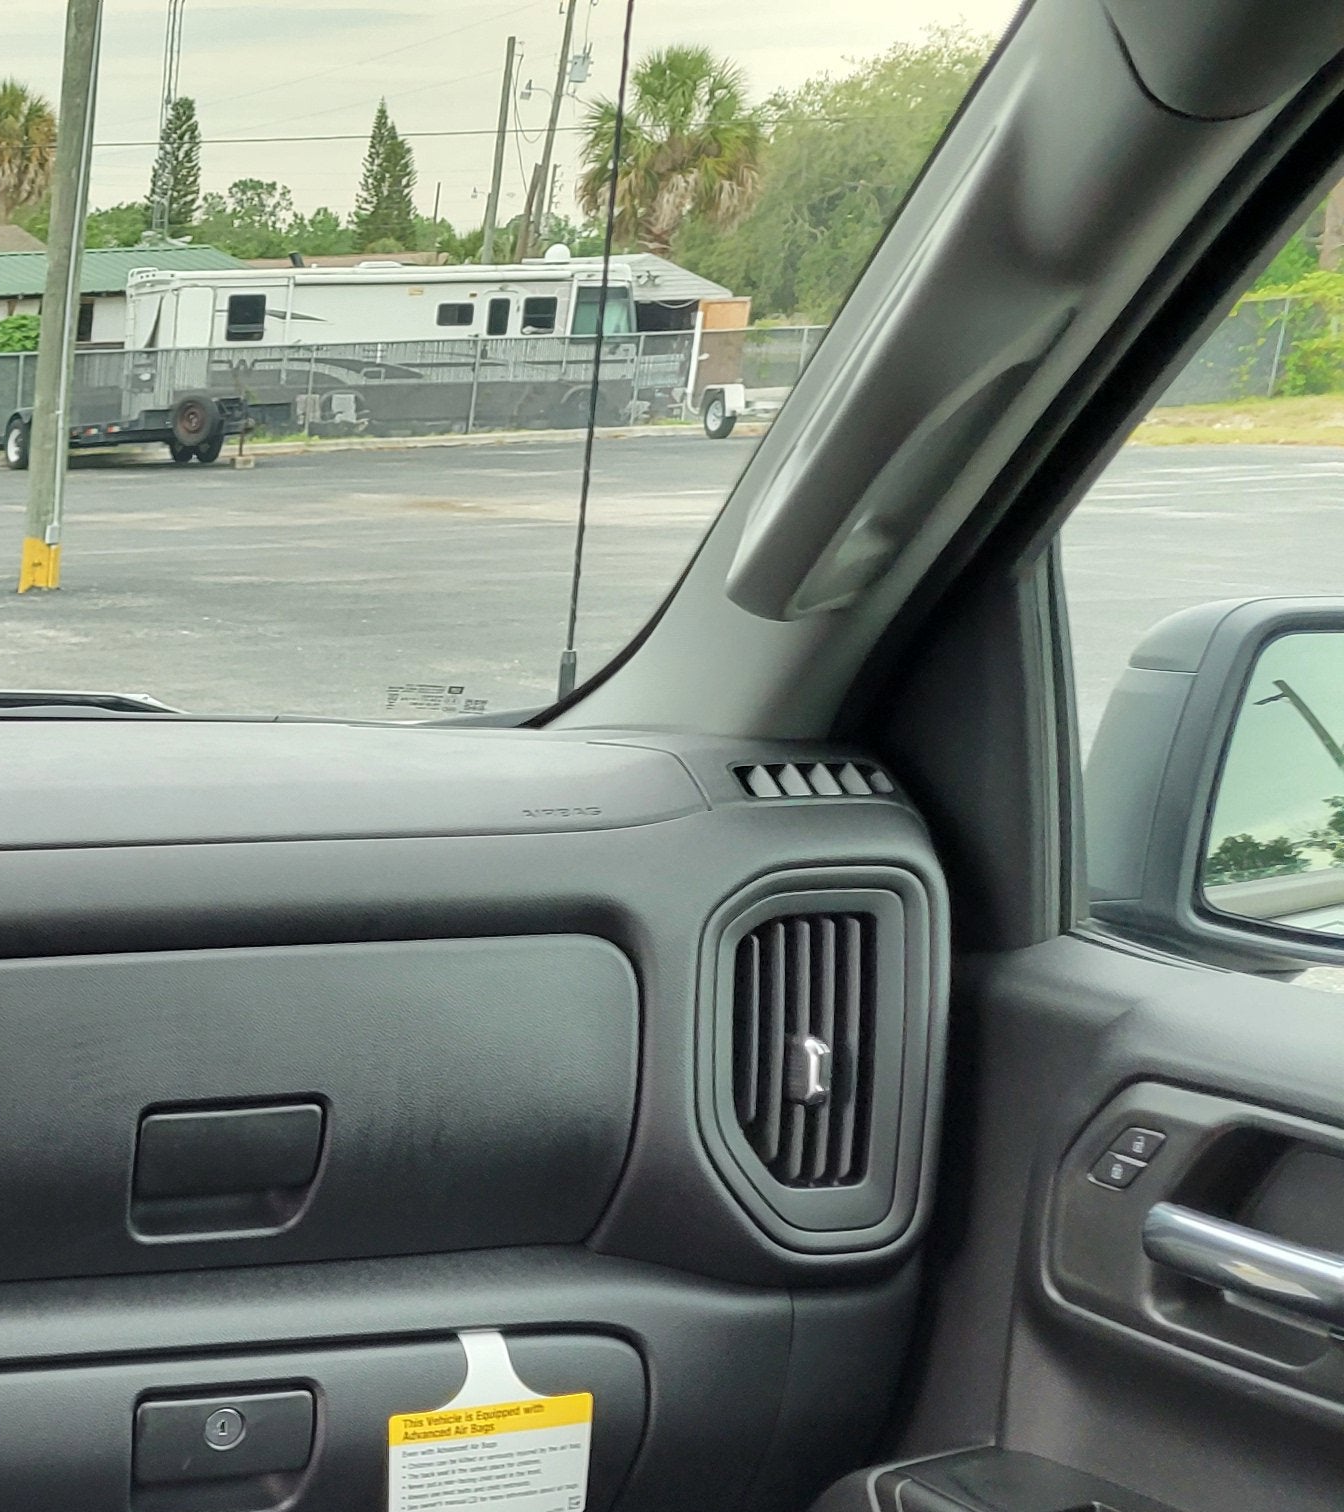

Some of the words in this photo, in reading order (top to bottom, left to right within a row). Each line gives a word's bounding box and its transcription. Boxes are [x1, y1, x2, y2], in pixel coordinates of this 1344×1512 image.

[402, 1419, 424, 1429] This
[426, 1415, 462, 1426] Vehicle
[464, 1412, 473, 1421] is
[476, 1406, 520, 1421] Equipped
[523, 1404, 544, 1414] with
[402, 1427, 452, 1441] Advanced
[455, 1425, 468, 1435] Air
[470, 1423, 495, 1434] Bags
